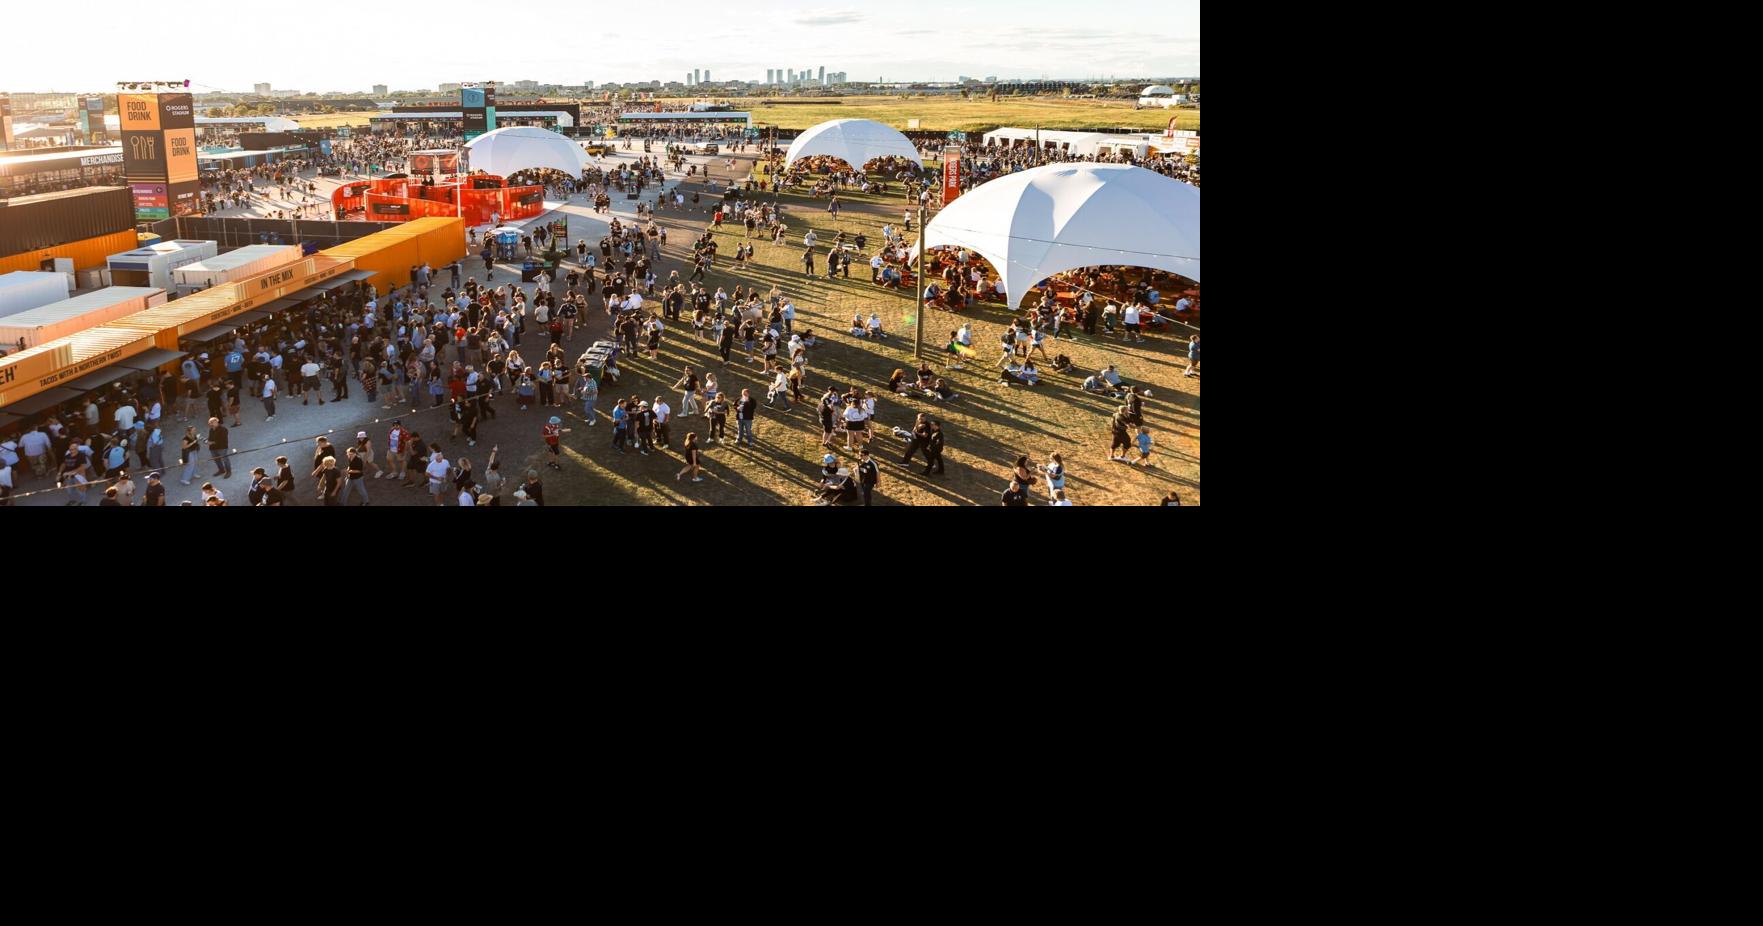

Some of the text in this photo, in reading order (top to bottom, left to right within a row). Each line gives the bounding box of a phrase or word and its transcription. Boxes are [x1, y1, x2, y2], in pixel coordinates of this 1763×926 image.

[127, 102, 146, 110] FOOD
[128, 112, 151, 120] DRINK
[171, 137, 187, 146] FOOD
[172, 146, 190, 156] DRINK
[80, 153, 124, 166] MERCHANDISE
[261, 278, 269, 289] IN
[269, 273, 281, 287] THE
[281, 268, 293, 280] MIX
[40, 375, 58, 386] TACOS
[59, 368, 74, 378] WITH
[79, 357, 106, 370] NORTHERN
[107, 351, 122, 361] TWIST
